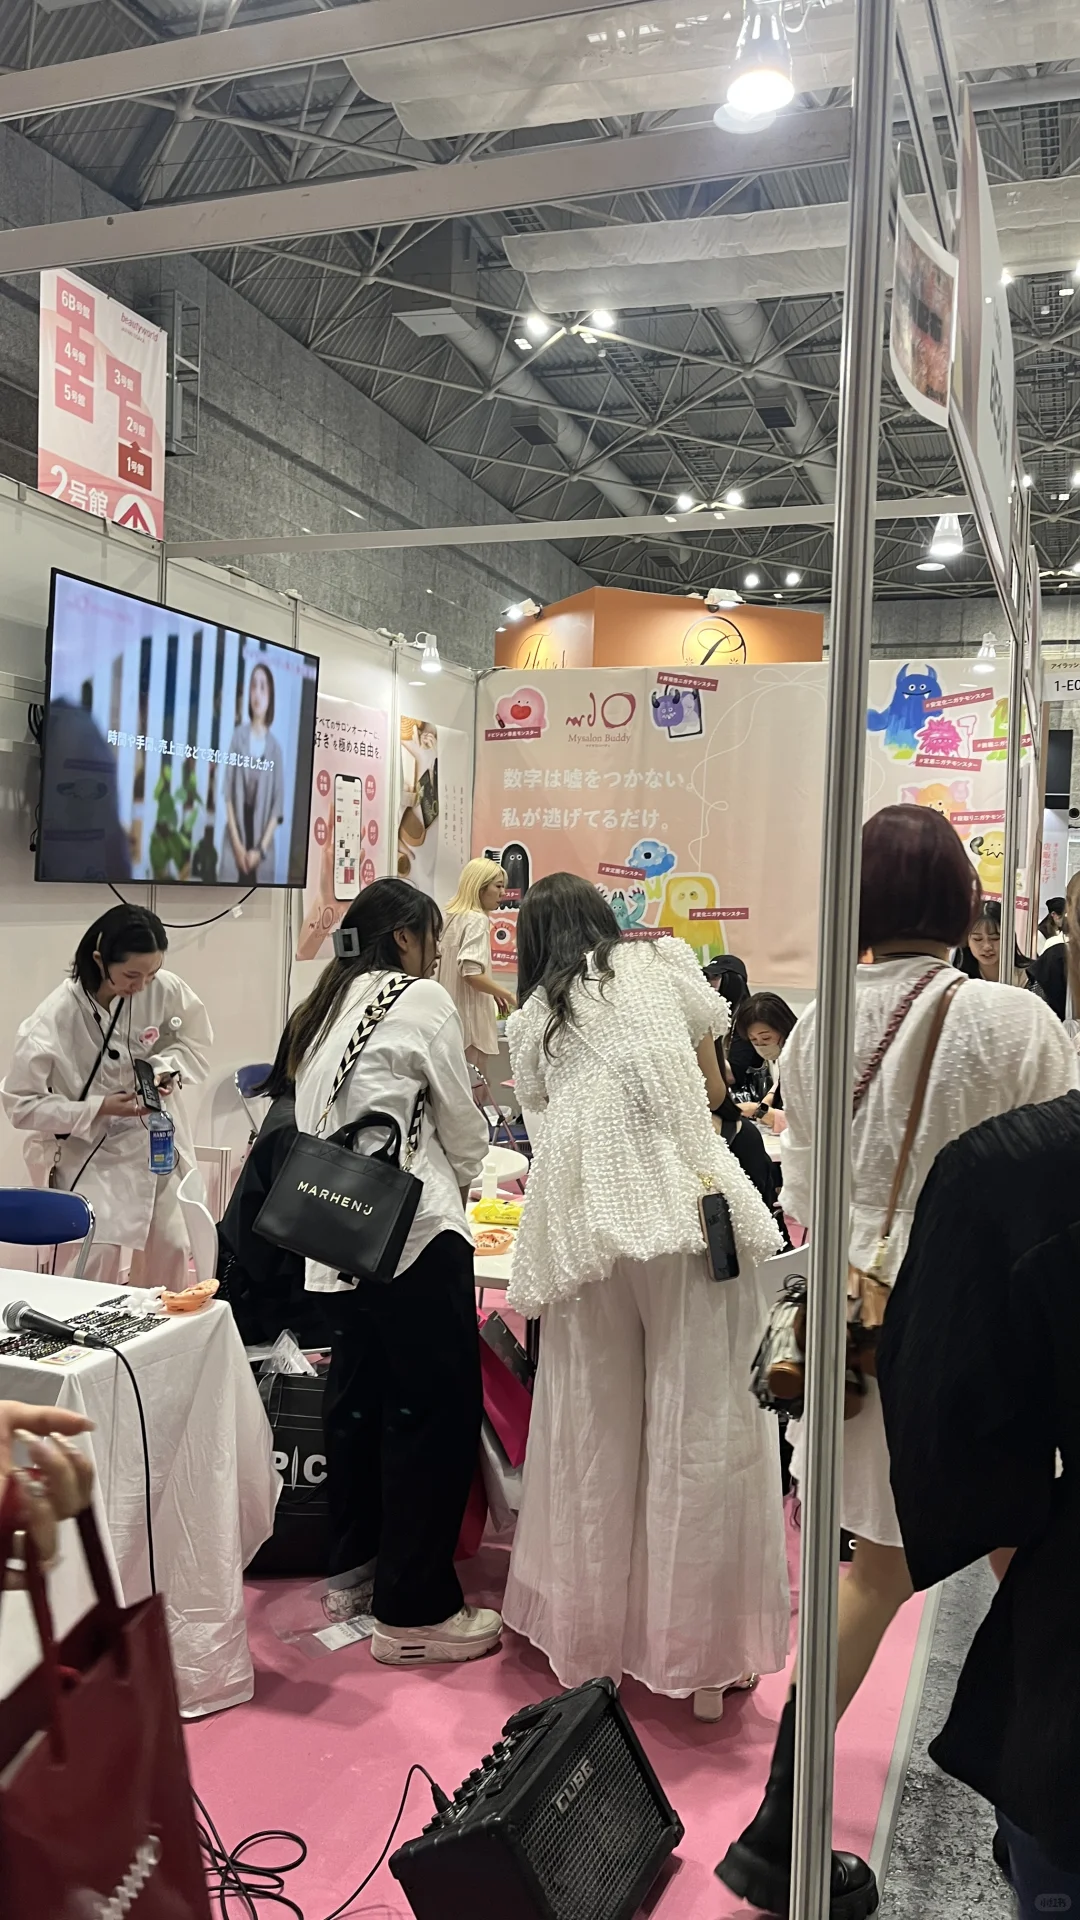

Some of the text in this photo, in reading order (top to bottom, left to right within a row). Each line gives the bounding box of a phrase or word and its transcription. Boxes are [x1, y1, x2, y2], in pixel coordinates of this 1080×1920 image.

[61, 290, 90, 319] 6B号館
[64, 342, 86, 366] 4号館
[114, 369, 134, 391] 3号館
[63, 384, 86, 407] 5号館
[126, 416, 146, 437] 2号館
[127, 457, 145, 476] 1号館
[50, 465, 108, 518] 2号館
[315, 717, 380, 741] べてのサロンオーナーに、
[568, 732, 631, 744] Mysalon Buddy
[503, 768, 693, 790] 数字は嘘をつかない。
[502, 808, 668, 830] 私が逃げてるだけ。
